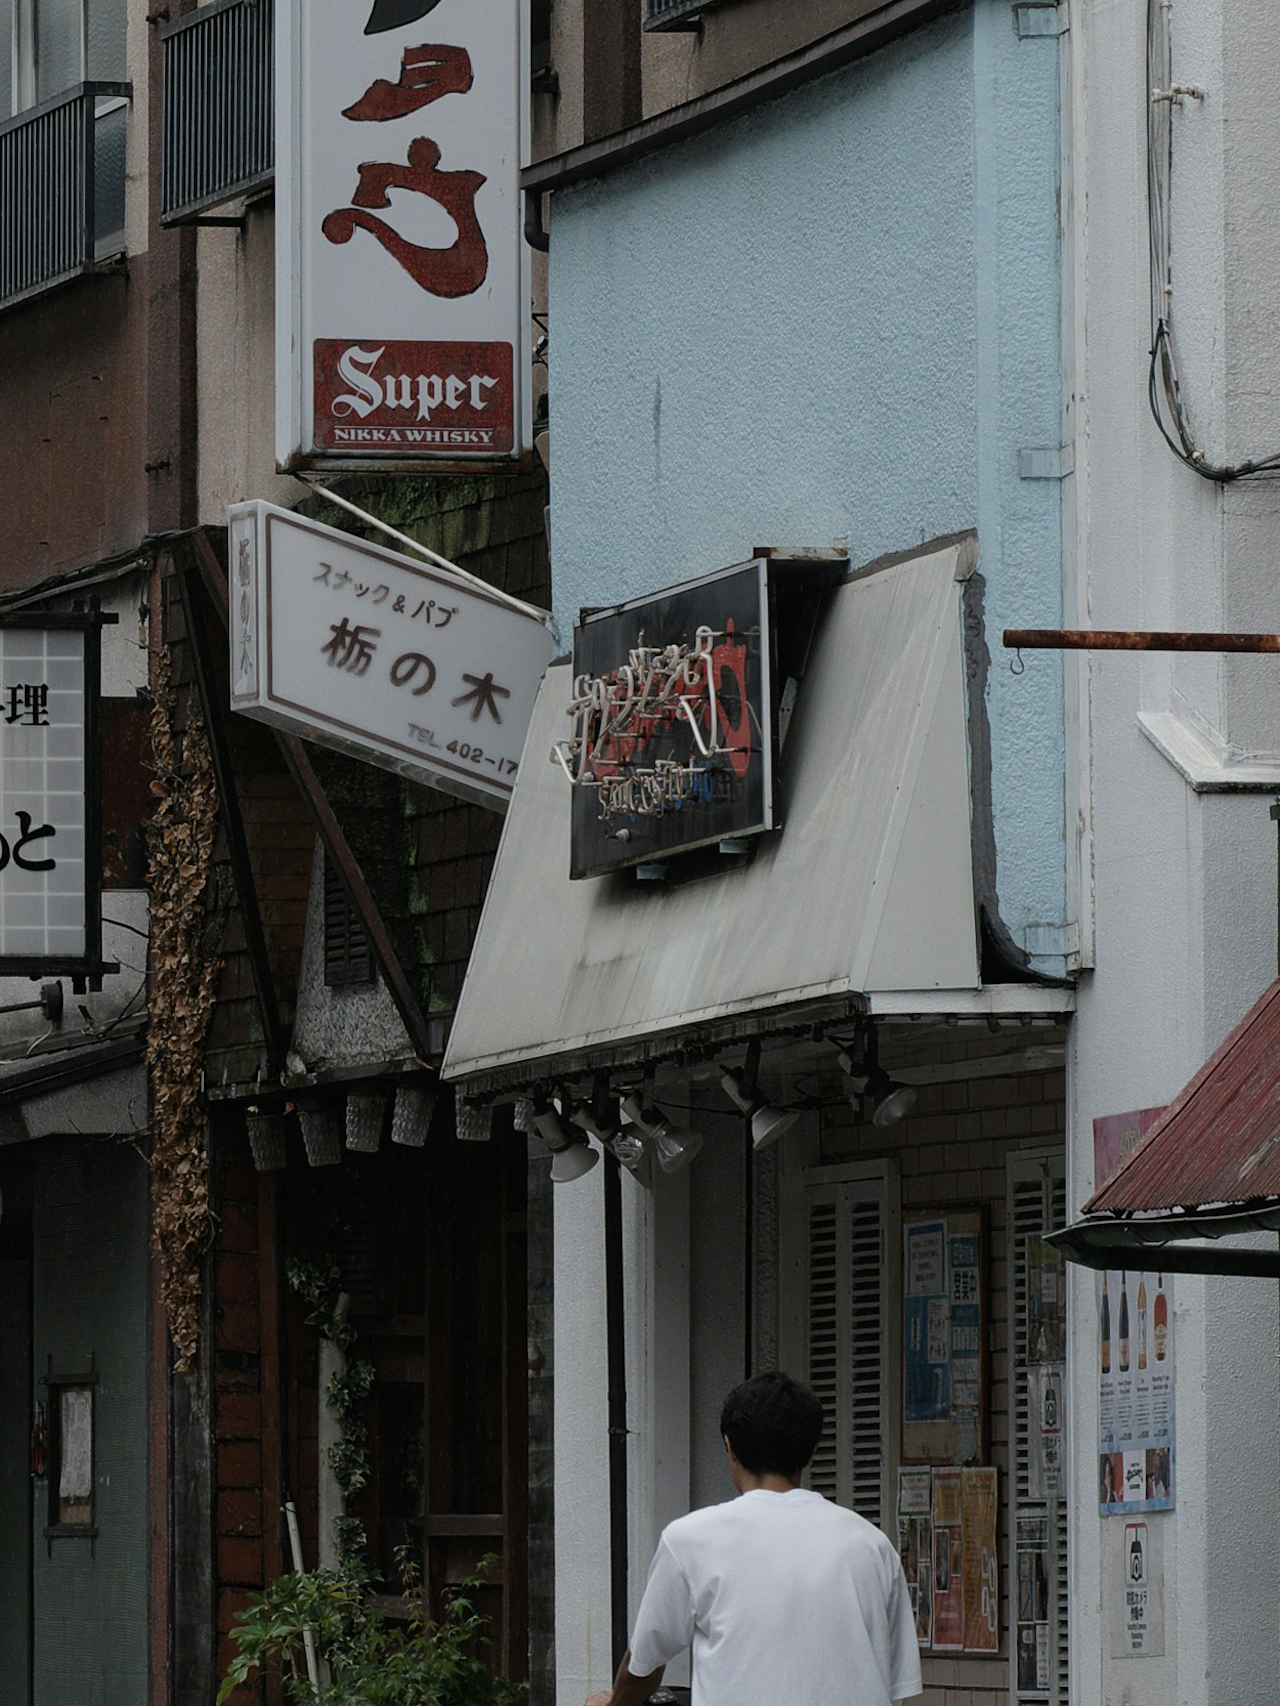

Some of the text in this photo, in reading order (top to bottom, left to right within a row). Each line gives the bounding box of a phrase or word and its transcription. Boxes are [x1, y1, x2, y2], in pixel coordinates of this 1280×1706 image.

[330, 345, 501, 422] Super
[334, 428, 494, 443] NIKKA WHISKY
[320, 617, 511, 725] 栃の木
